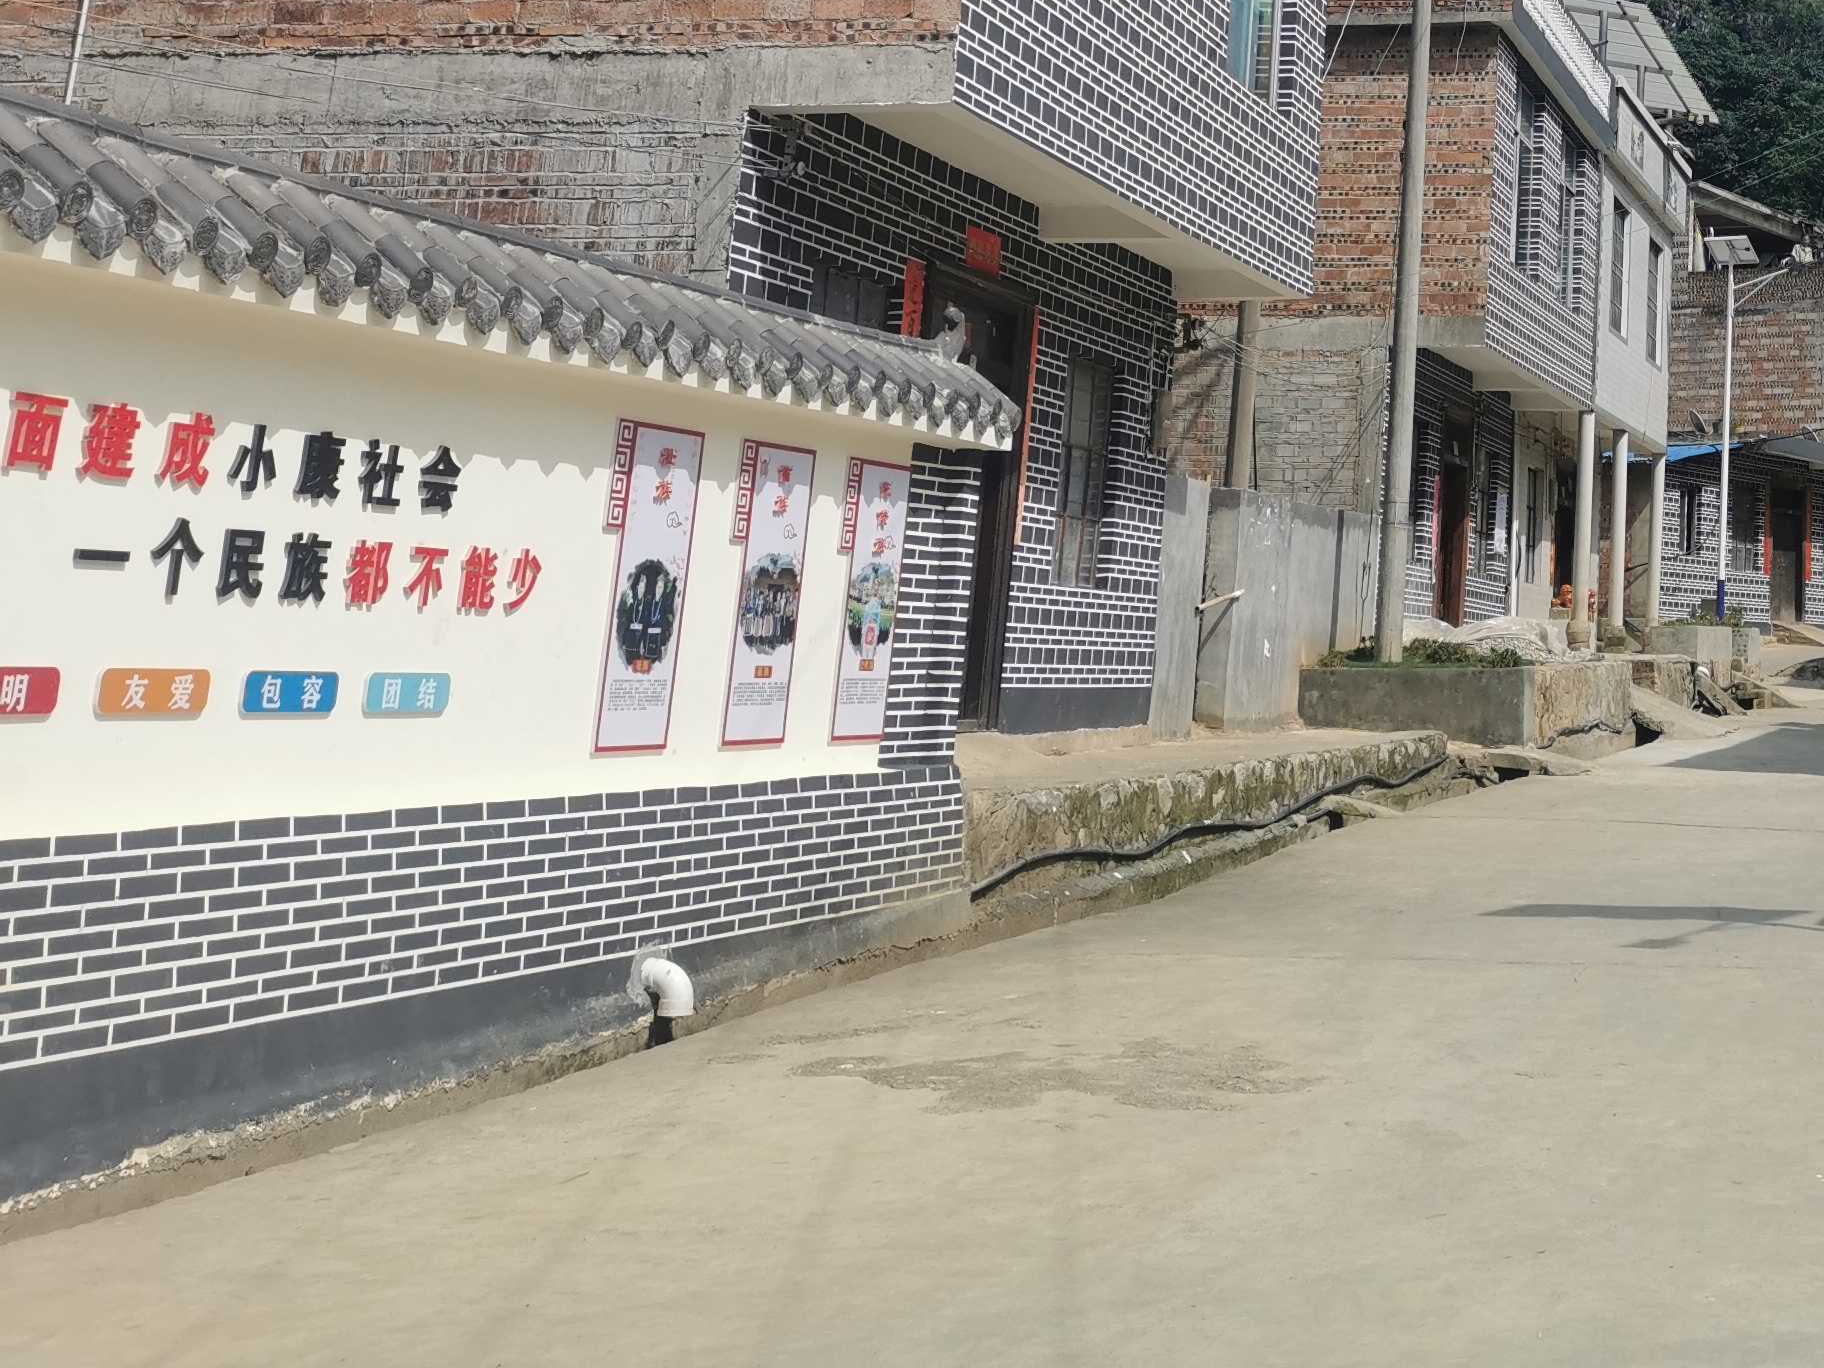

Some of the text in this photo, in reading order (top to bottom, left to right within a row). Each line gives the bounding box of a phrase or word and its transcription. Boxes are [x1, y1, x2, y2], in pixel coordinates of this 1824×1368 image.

[3, 391, 463, 513] 面建成小康社会
[73, 516, 543, 615] 一个民族都不能少
[121, 674, 196, 711] 友爱
[260, 674, 325, 710] 包容
[381, 676, 438, 710] 团结
